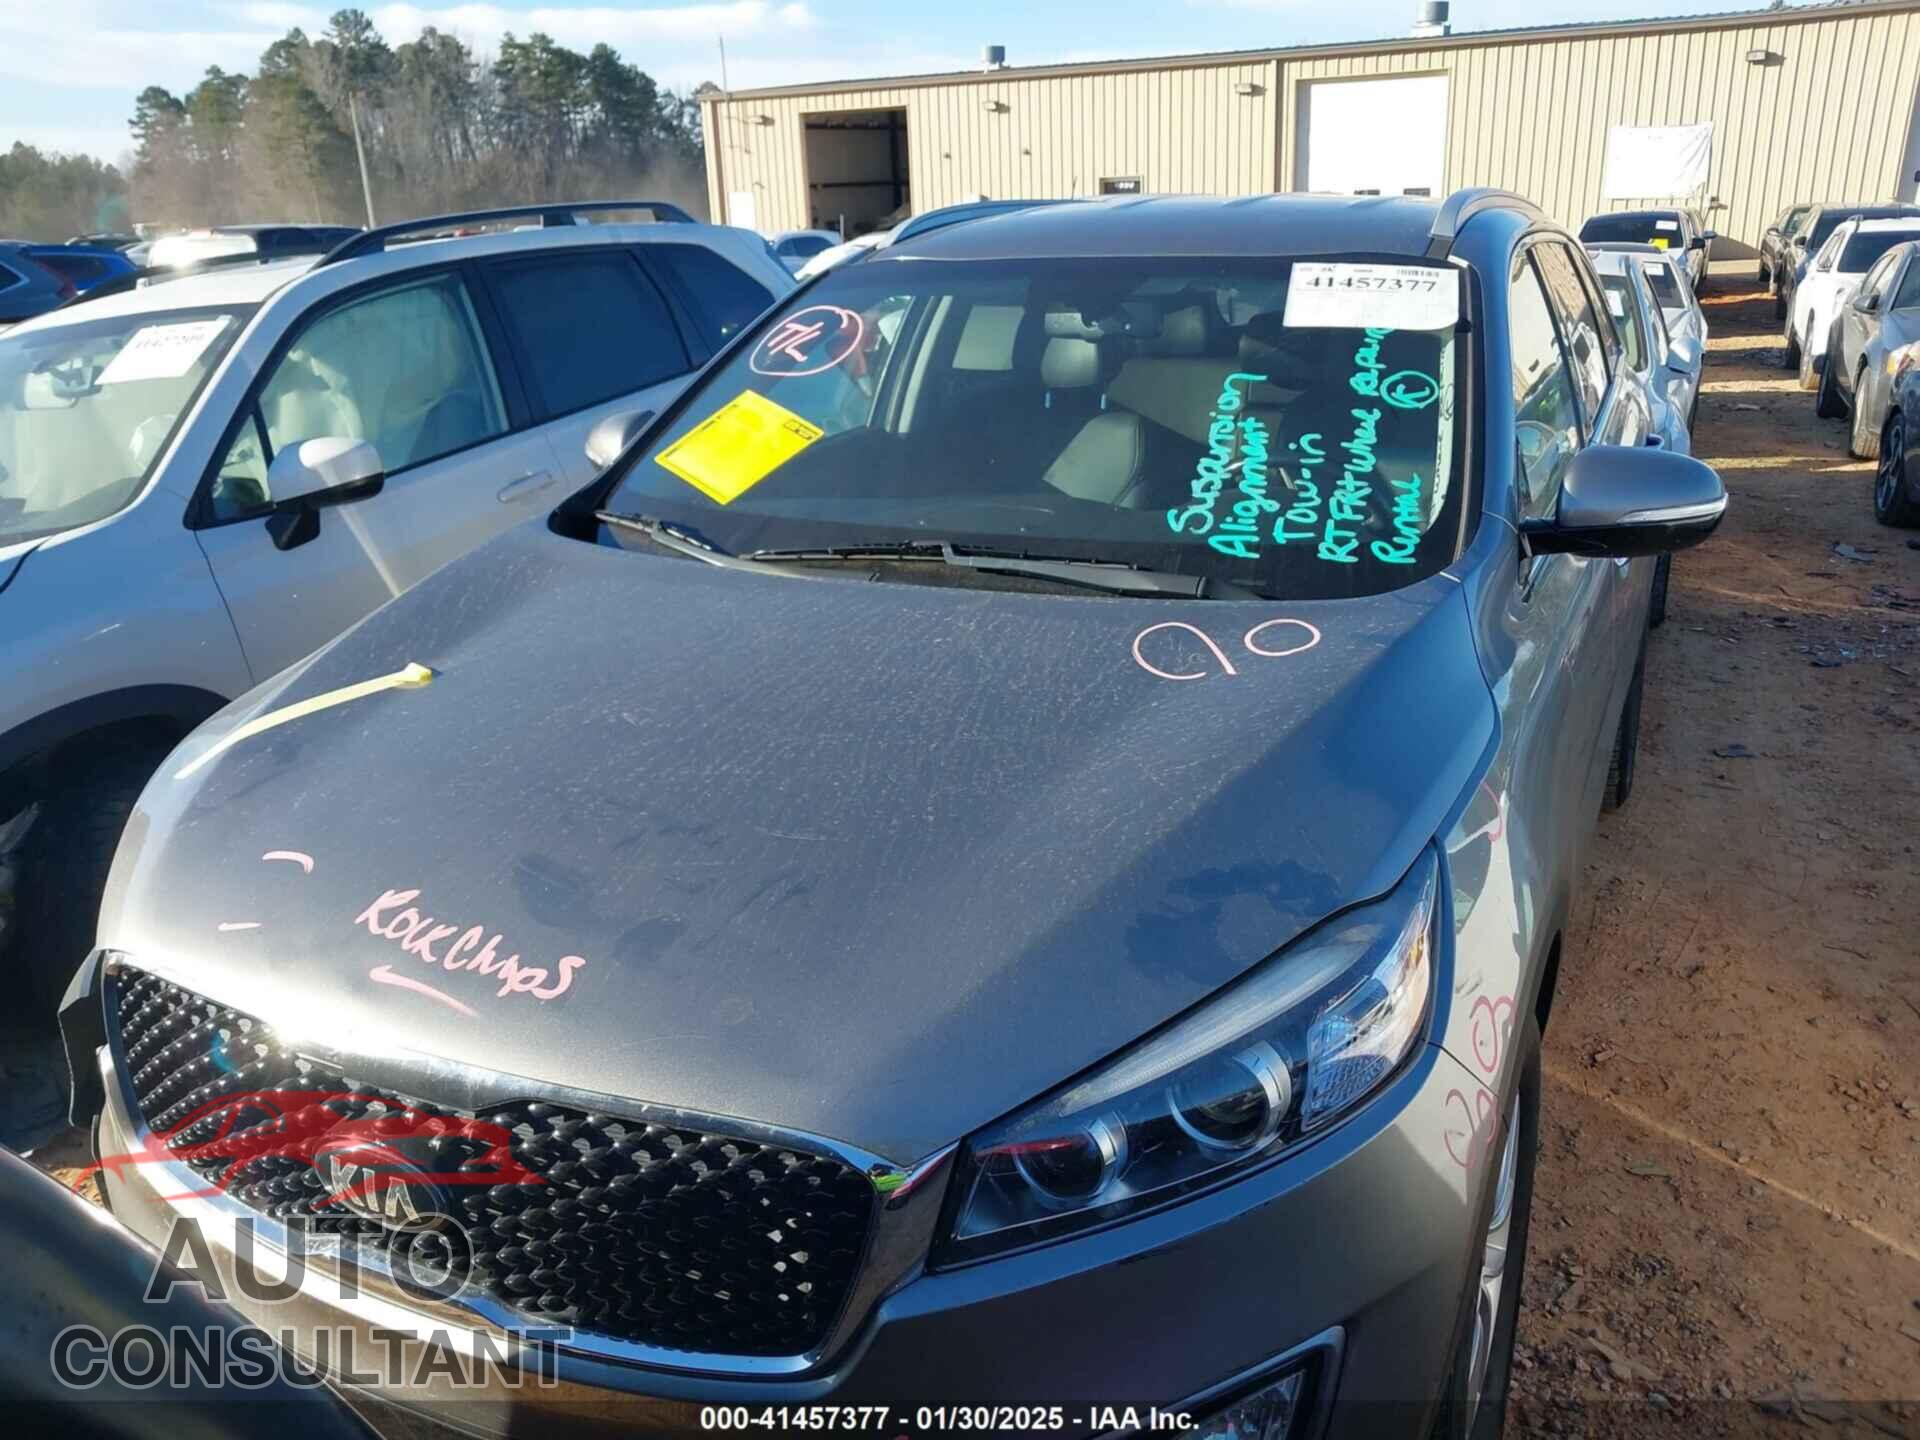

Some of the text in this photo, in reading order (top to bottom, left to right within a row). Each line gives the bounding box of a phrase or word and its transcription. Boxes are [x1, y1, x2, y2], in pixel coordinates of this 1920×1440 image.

[1305, 276, 1438, 292] 41457377
[1208, 416, 1280, 559] Alignment
[328, 1155, 417, 1222] KIA
